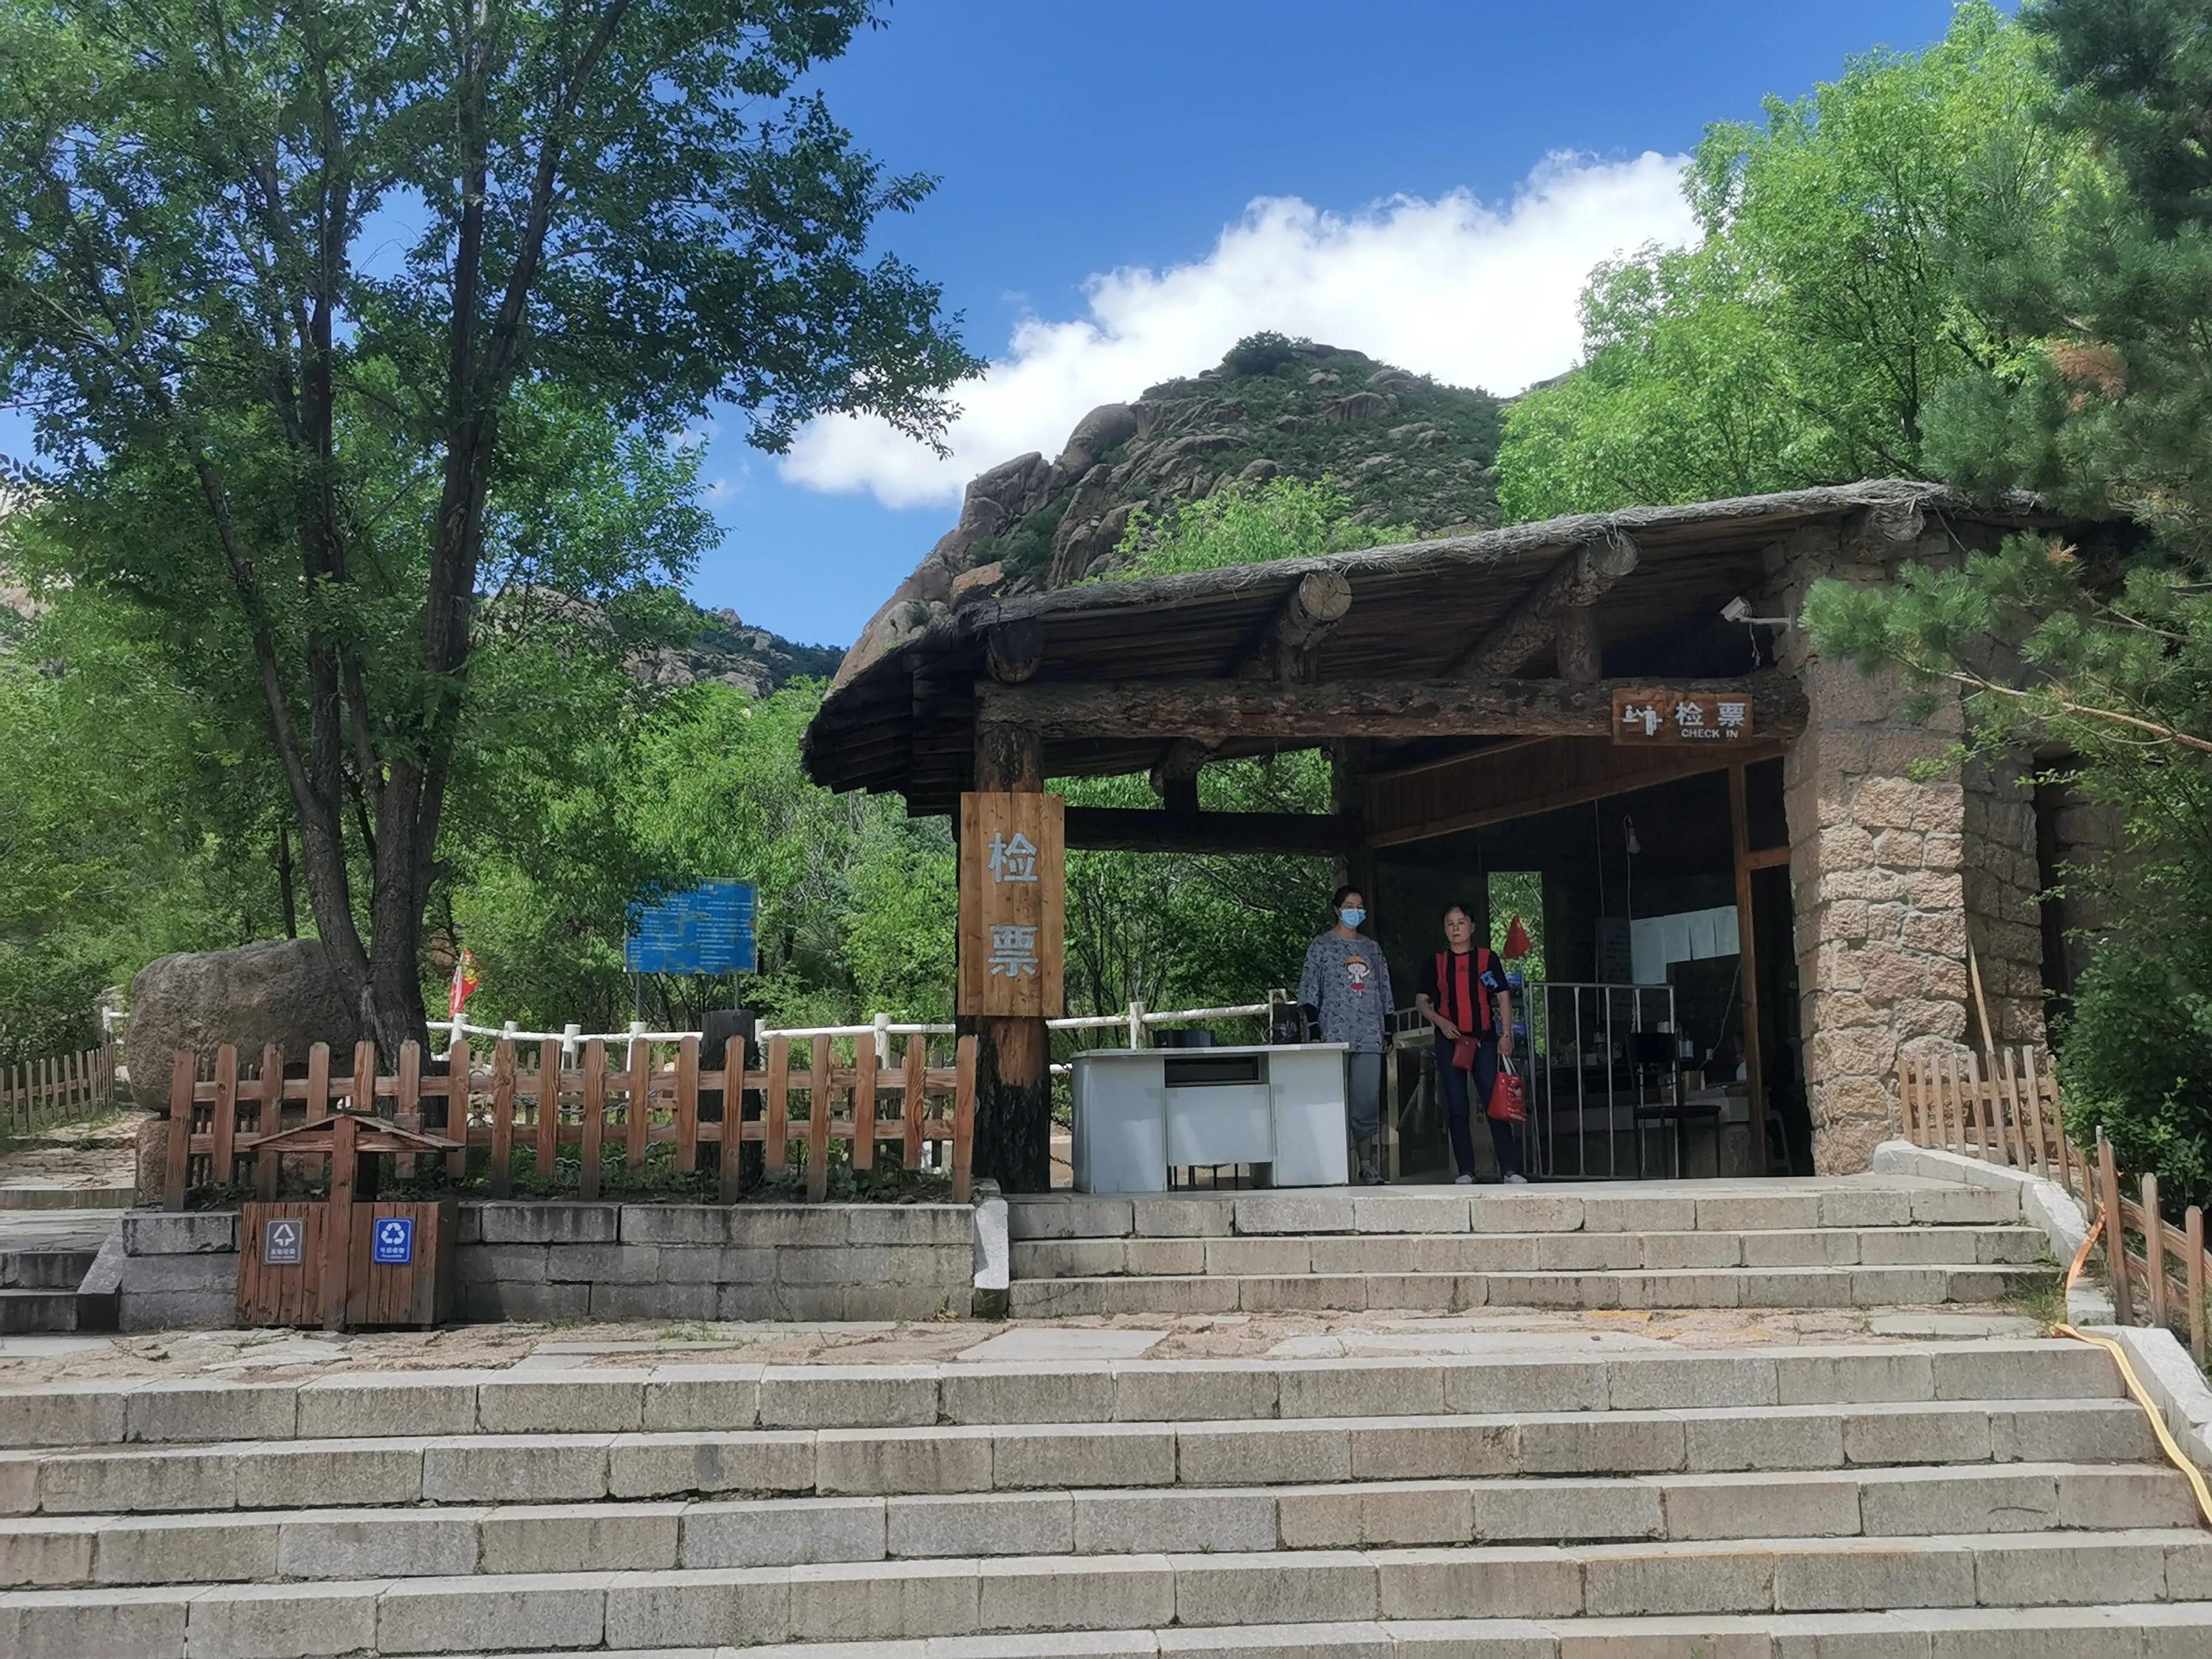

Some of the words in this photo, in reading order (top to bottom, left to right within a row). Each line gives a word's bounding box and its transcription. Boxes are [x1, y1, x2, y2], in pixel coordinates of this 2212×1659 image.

[1675, 702, 1745, 726] 检票
[1681, 728, 1720, 738] CHECK
[1726, 729, 1738, 738] IN
[988, 831, 1038, 977] 检票
